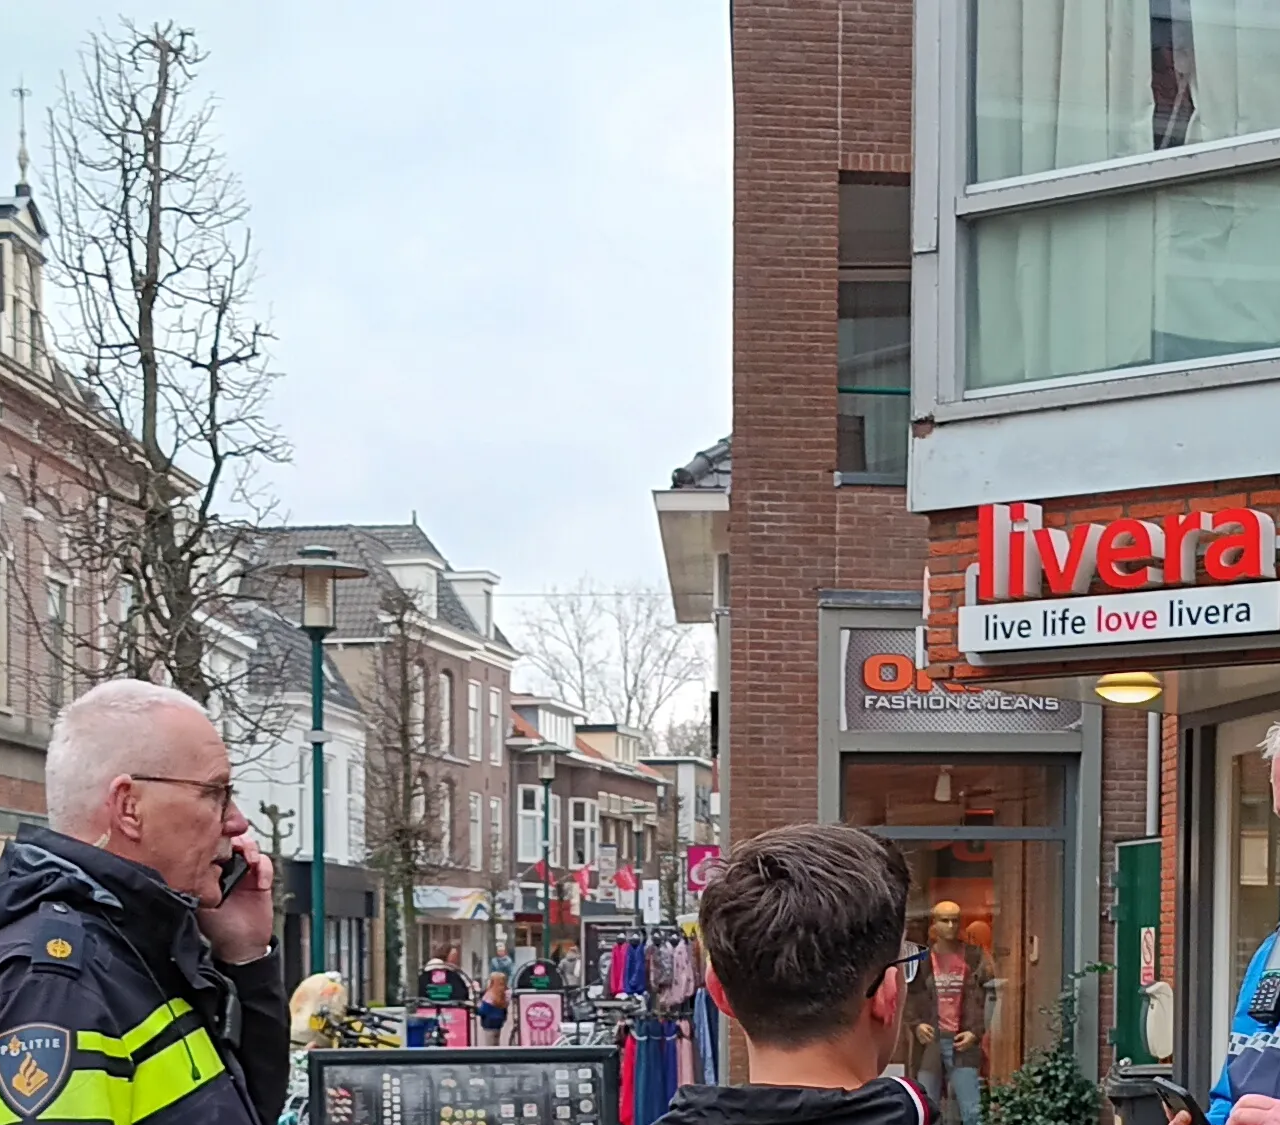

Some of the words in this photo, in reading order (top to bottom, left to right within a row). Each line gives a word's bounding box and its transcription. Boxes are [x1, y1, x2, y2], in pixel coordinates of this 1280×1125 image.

[978, 502, 1266, 600] livera
[984, 614, 1032, 641] live
[1042, 608, 1086, 636] life
[1096, 605, 1158, 633] love
[1169, 600, 1252, 628] livera
[864, 695, 960, 710] FASHION
[966, 697, 982, 710] &
[987, 697, 1060, 711] JEANS
[0, 1037, 60, 1057] POLITIE
